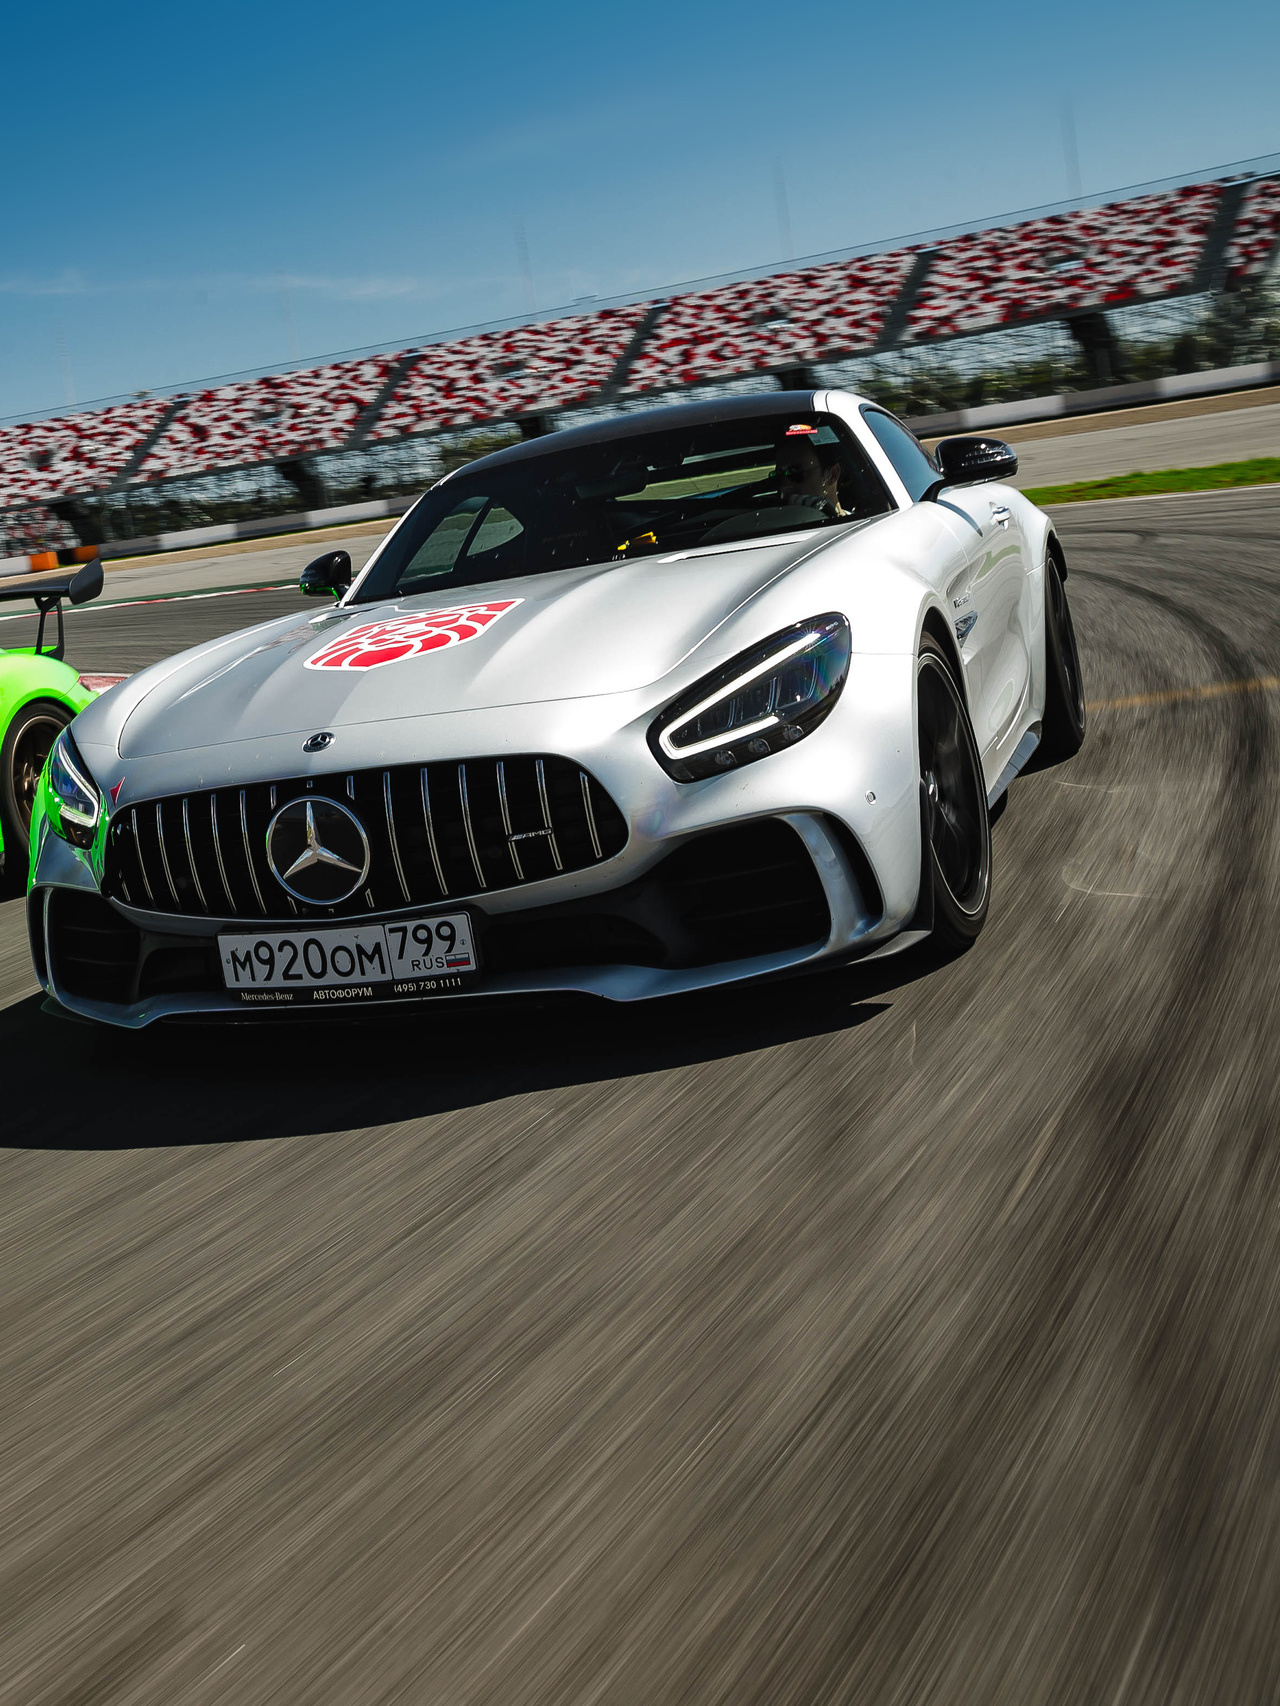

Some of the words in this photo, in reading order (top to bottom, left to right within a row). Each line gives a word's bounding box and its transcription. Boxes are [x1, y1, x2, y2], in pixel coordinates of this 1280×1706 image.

[388, 921, 457, 961] 799
[411, 956, 445, 972] RUS
[313, 986, 373, 1000] АВТОФОРУМ
[394, 983, 417, 993] (495)
[419, 980, 437, 990] 730
[440, 977, 462, 988] 1111
[241, 991, 294, 1001] Mercedes-Benz
